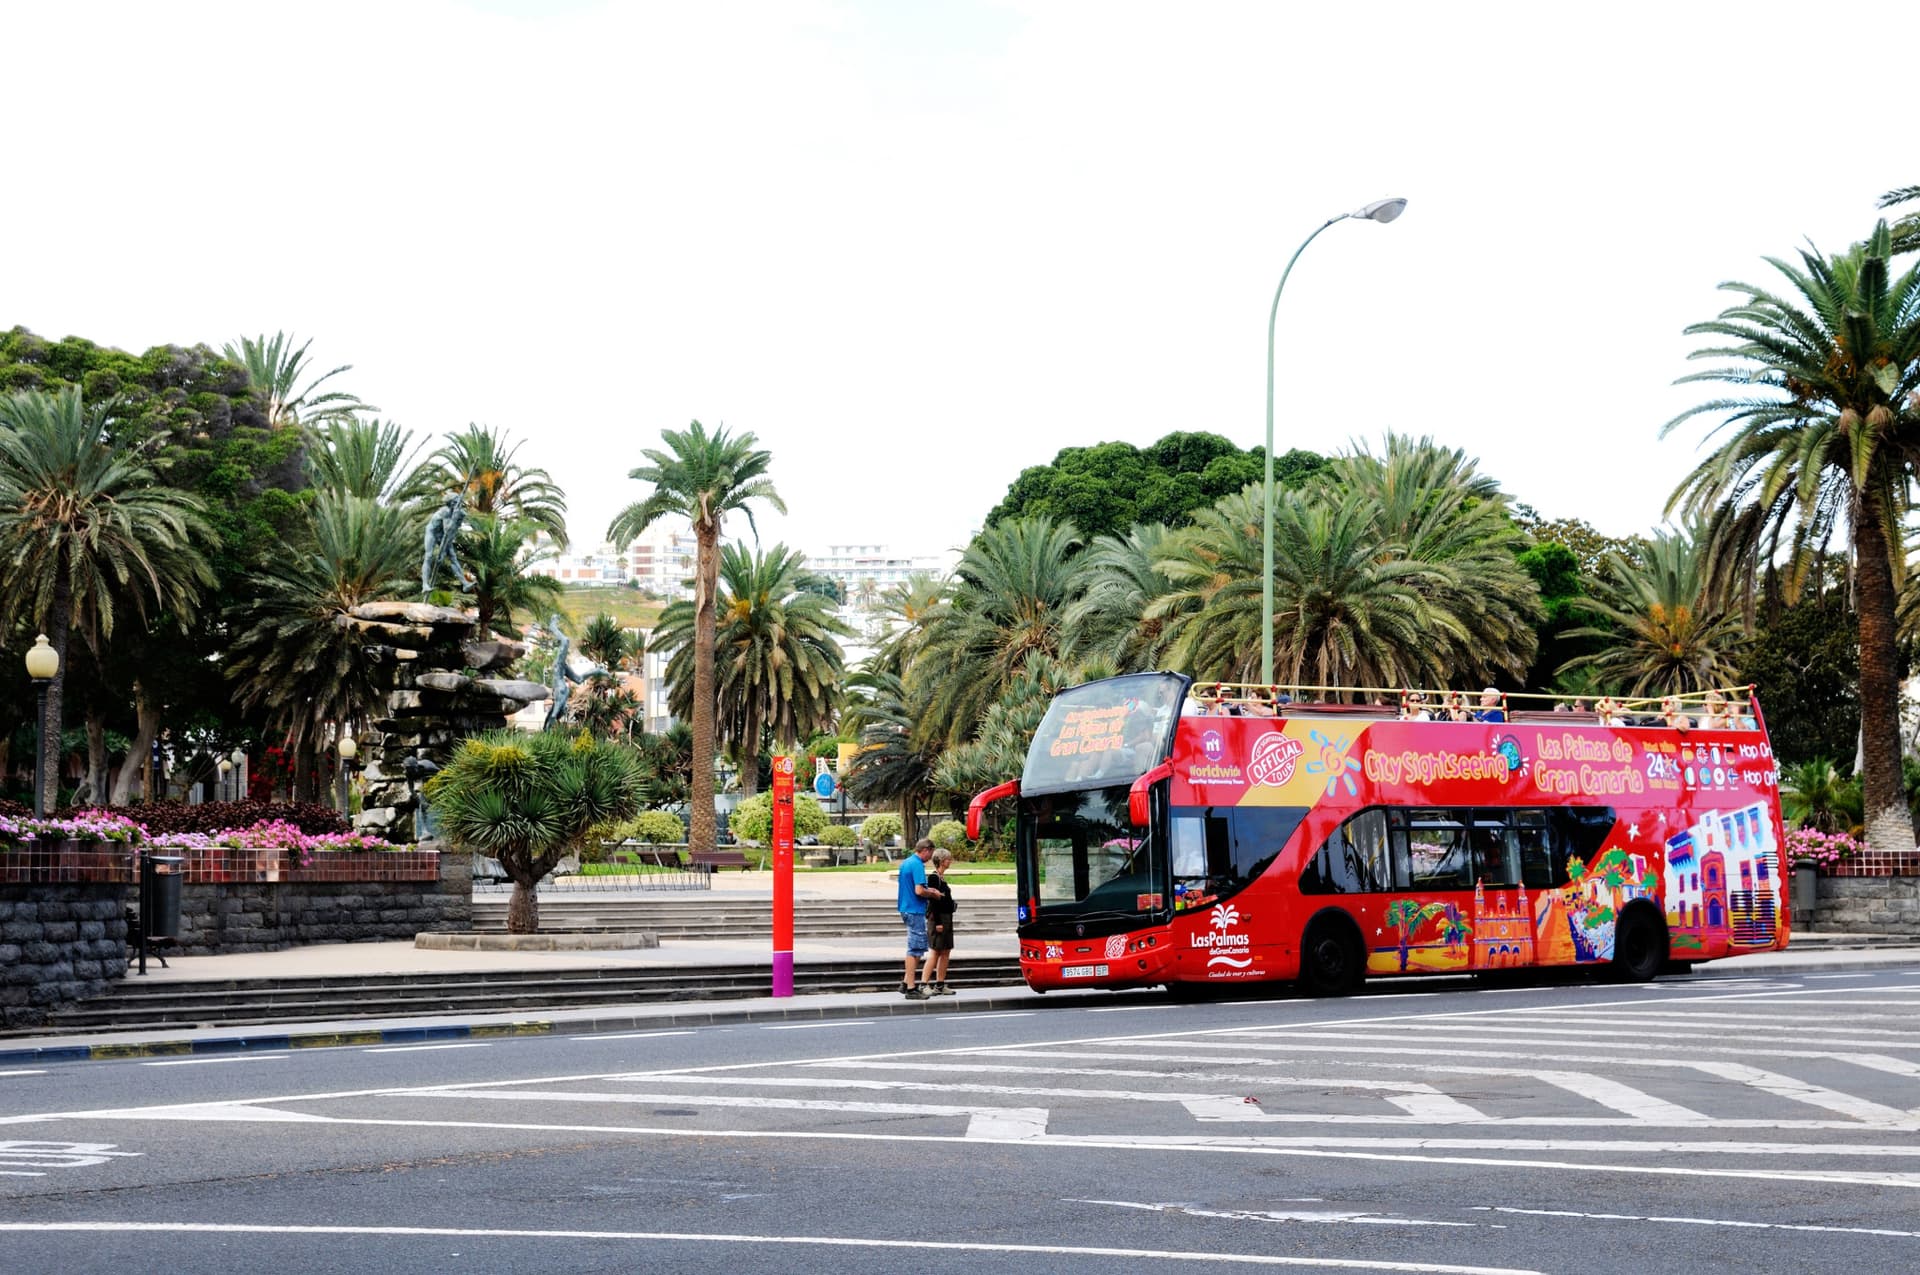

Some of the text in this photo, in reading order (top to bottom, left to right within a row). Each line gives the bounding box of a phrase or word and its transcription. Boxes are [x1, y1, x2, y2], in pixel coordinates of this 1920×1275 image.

[1253, 741, 1300, 779] OFFICIAL
[1537, 733, 1563, 760] Las
[1563, 733, 1612, 762] Palmas
[1612, 736, 1633, 763] de
[1739, 742, 1773, 759] Hop On
[1272, 762, 1294, 782] TOUR
[1534, 760, 1644, 795] Gran Canaria
[1743, 769, 1762, 785] Hop
